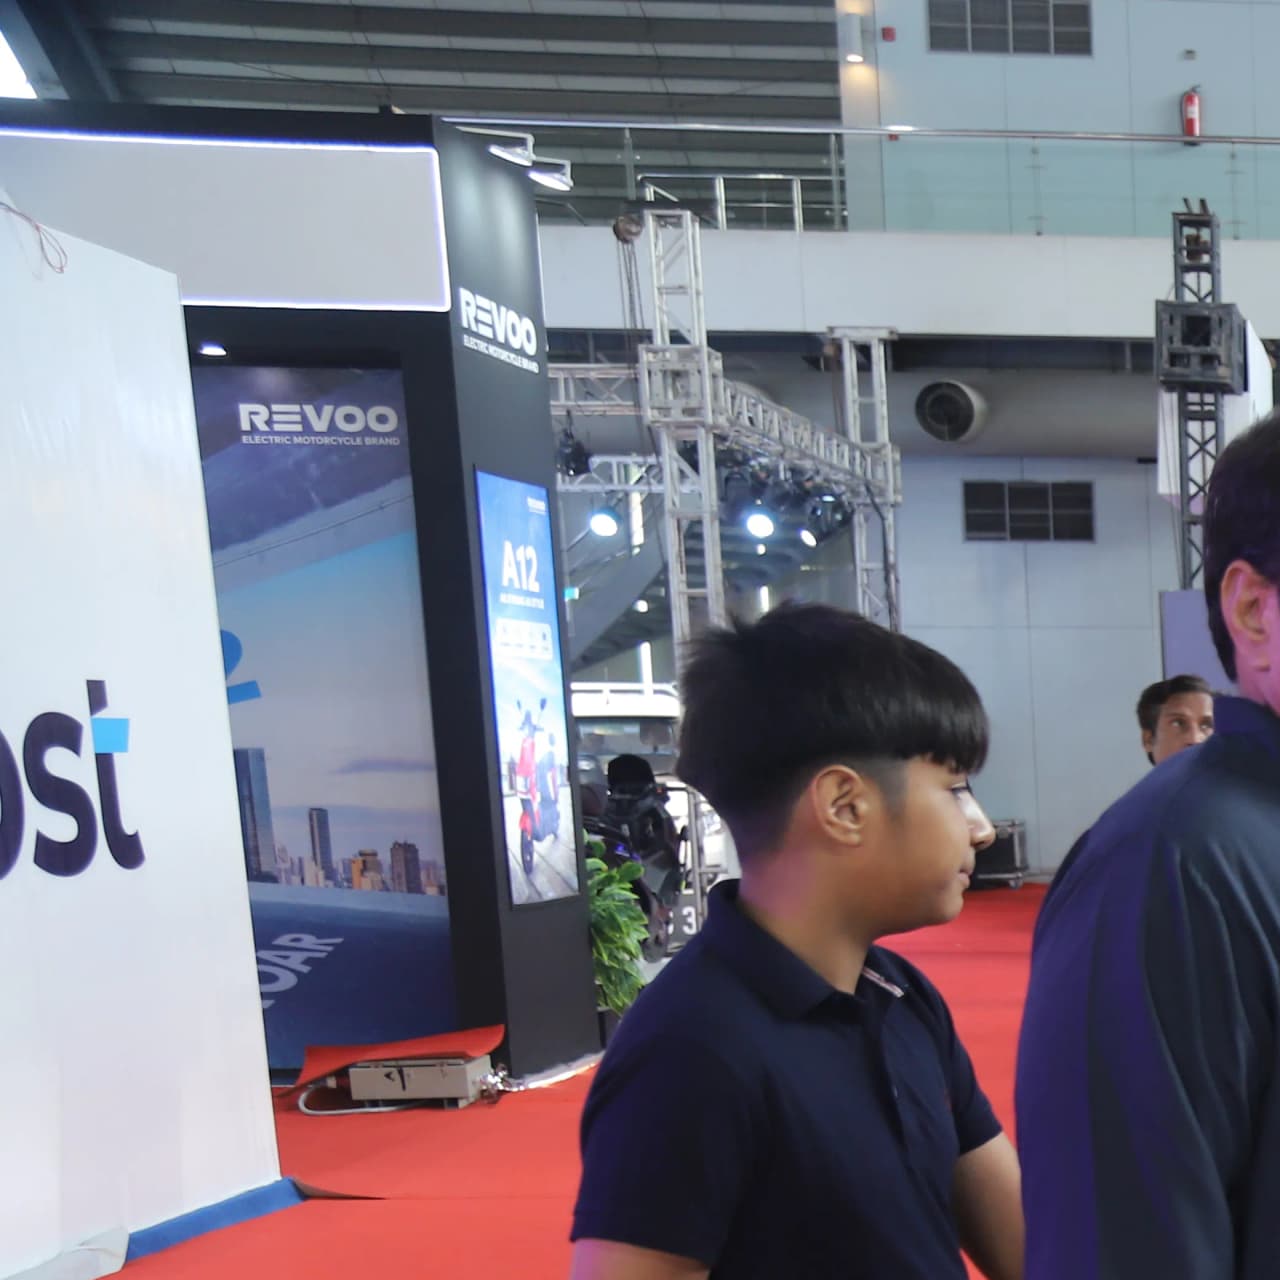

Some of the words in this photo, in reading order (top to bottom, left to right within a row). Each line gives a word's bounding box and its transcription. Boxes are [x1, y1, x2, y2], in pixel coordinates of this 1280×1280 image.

[459, 287, 537, 356] REVOO
[238, 403, 399, 433] REVOO
[242, 435, 292, 445] ELECTRIC
[293, 435, 363, 446] MOTORCYCLE
[364, 437, 400, 447] BRAND
[501, 541, 540, 593] A12
[256, 933, 345, 1008] OAR
